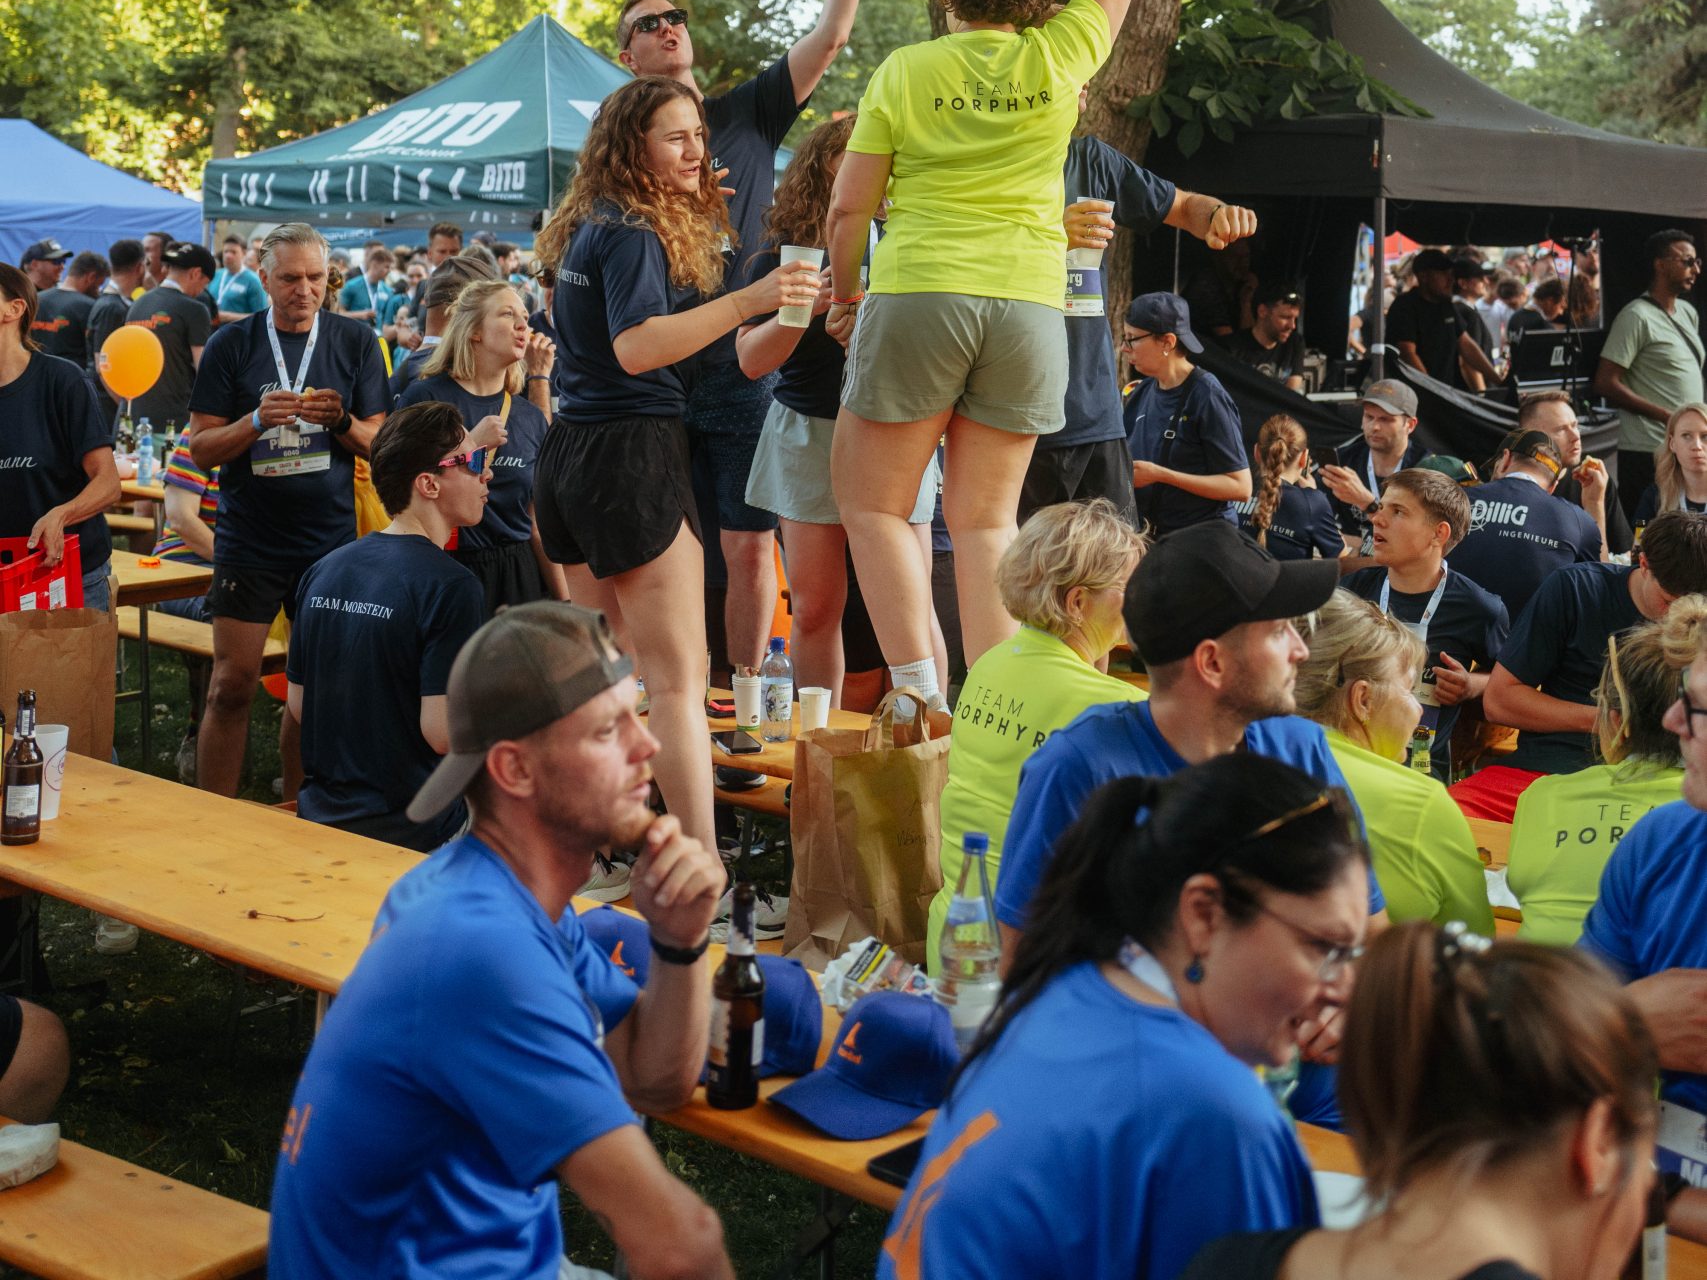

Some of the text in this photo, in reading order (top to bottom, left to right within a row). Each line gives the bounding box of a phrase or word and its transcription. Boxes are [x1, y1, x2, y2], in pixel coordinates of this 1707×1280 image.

[962, 81, 1022, 96] TEAM
[934, 90, 1052, 112] PORPHYR
[347, 100, 522, 153] BITO
[479, 161, 525, 192] BITO
[1498, 530, 1559, 548] INGENIEURE
[310, 596, 393, 619] TEAM MORSTEIN
[974, 686, 1024, 718] TEAM
